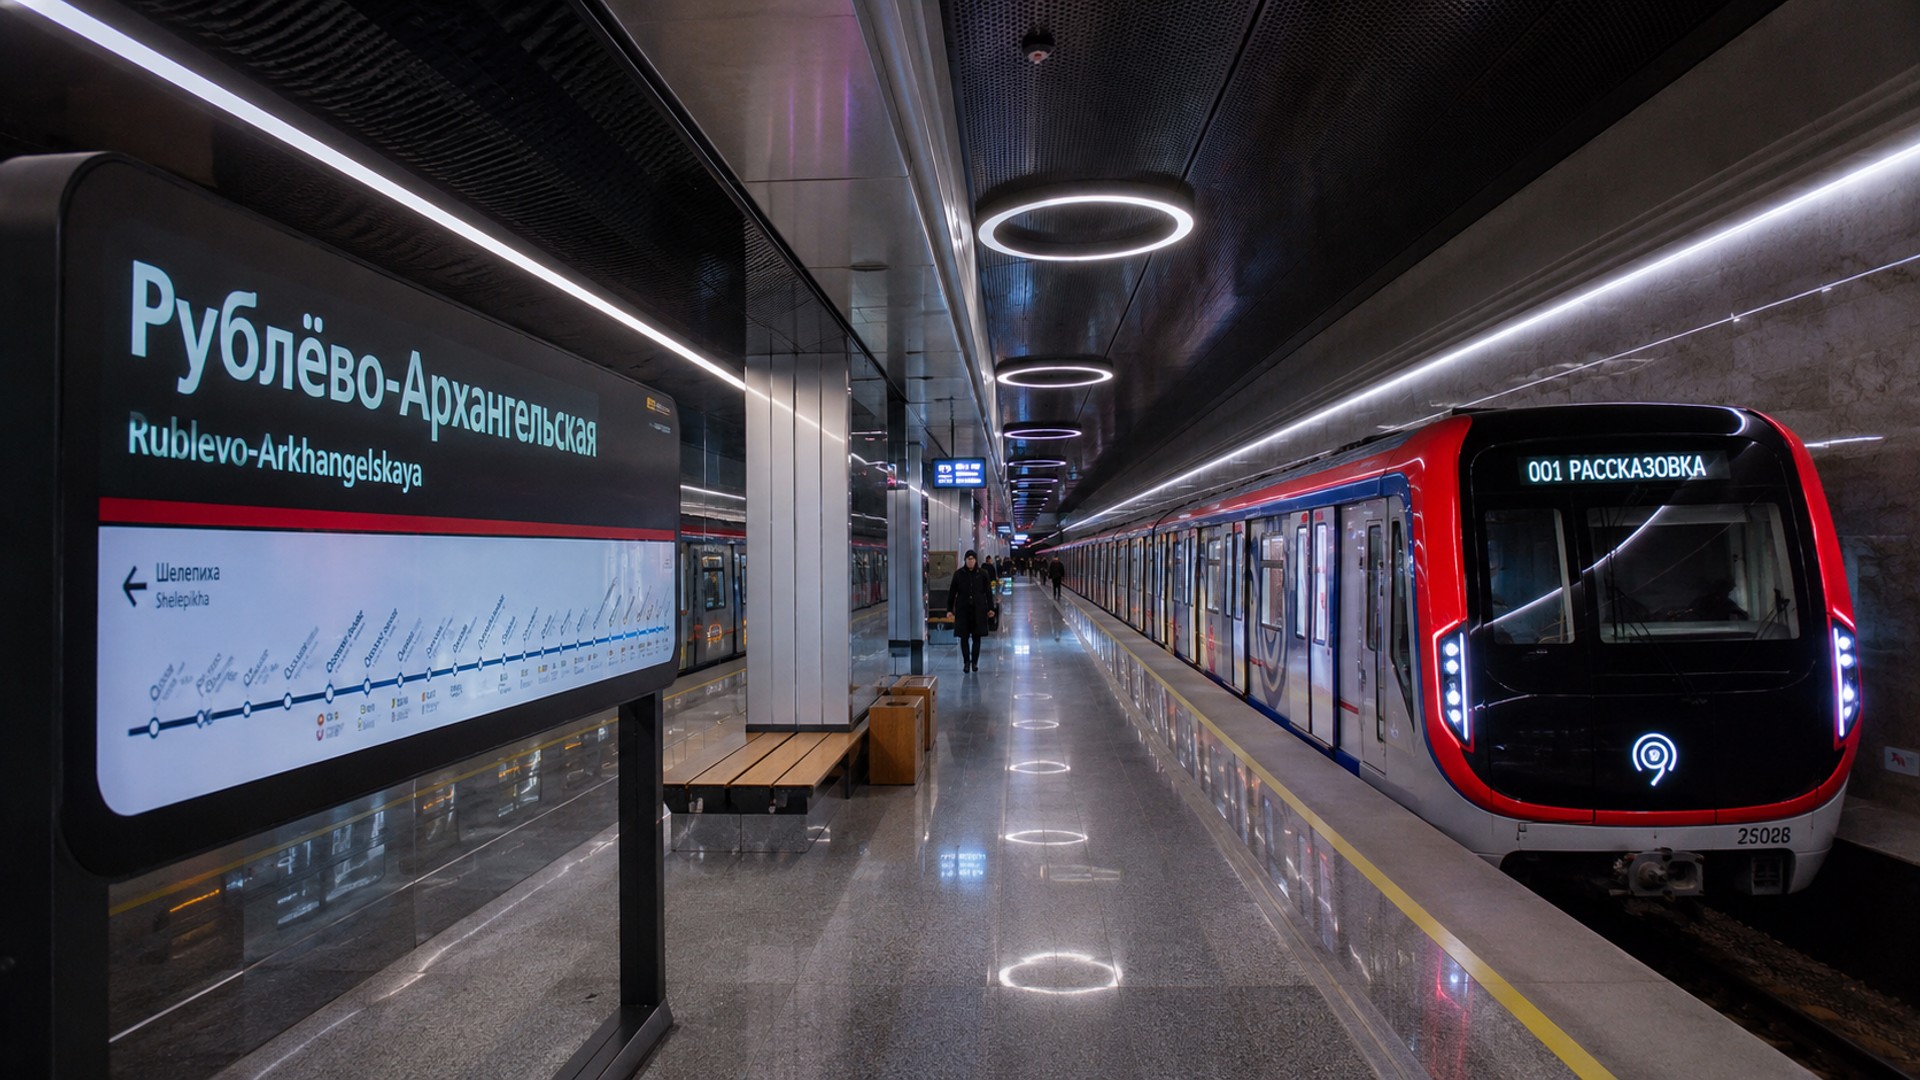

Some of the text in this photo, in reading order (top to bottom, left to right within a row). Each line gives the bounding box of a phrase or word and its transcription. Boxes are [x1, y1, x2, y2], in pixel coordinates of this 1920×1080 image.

[130, 259, 597, 457] Рублёво-Архангельская
[128, 410, 423, 494] Rublevo-Arkhangelskaya
[1528, 455, 1707, 482] 001 РАССКАЗОВКА
[156, 562, 220, 582] Шелепиха
[156, 591, 210, 611] Shelepikha
[1737, 826, 1791, 845] 25028
